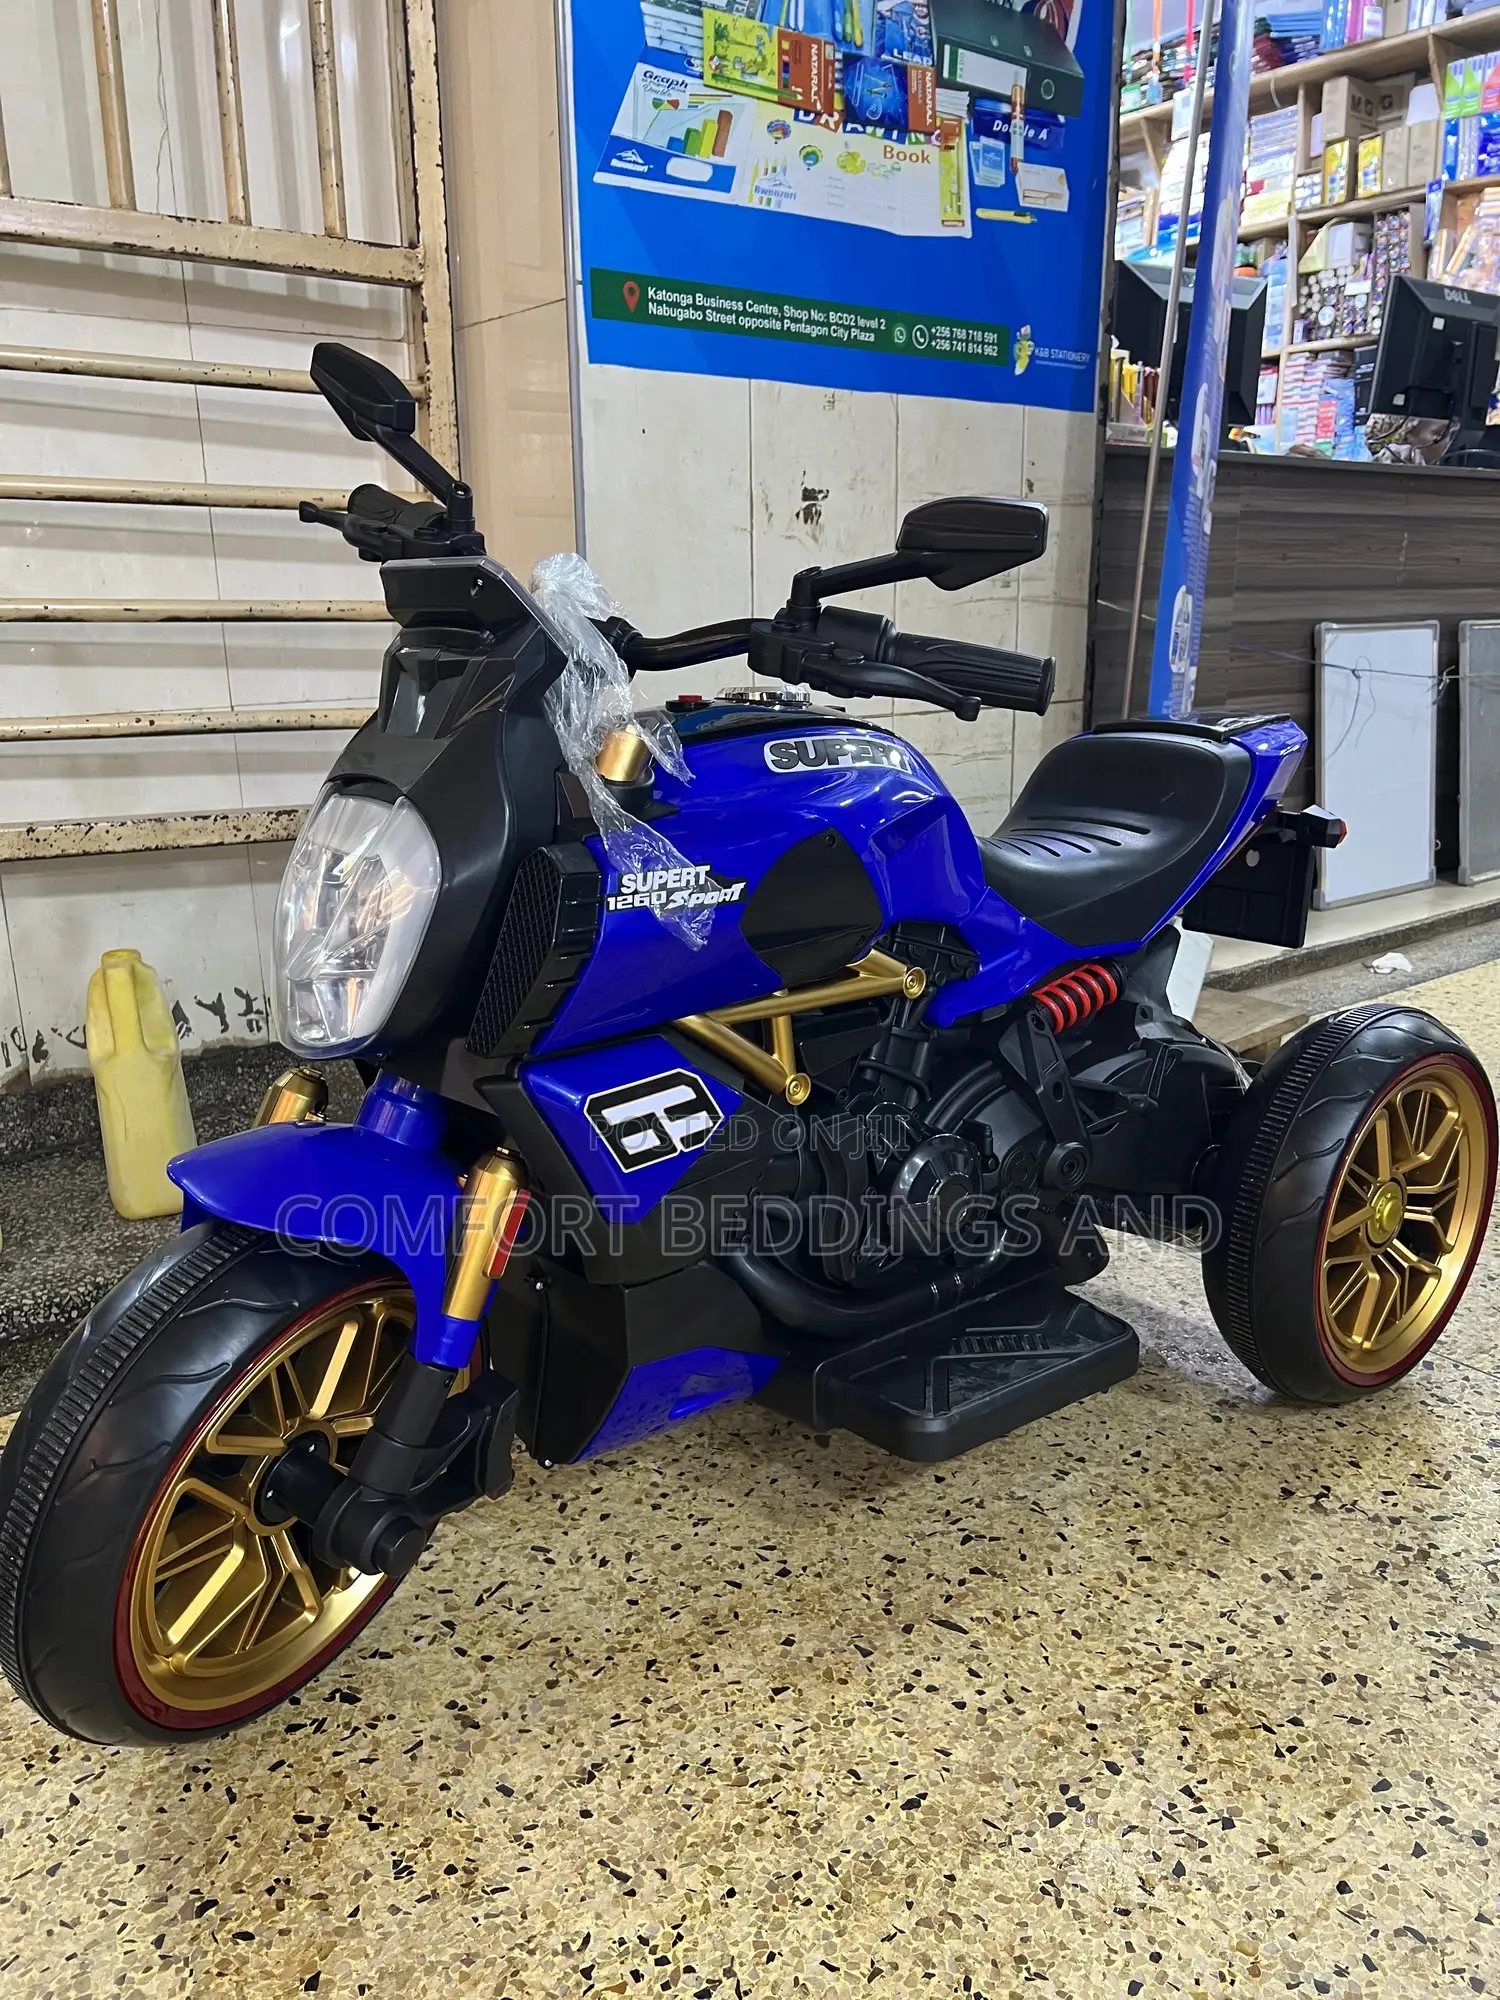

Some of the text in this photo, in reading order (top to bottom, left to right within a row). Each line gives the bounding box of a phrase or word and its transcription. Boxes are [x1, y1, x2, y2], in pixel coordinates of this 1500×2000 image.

[643, 70, 688, 89] Graph
[993, 120, 1049, 140] Dole A
[882, 145, 931, 164] Book
[1443, 287, 1472, 305] DELL
[647, 286, 886, 330] Katonga Business Centre, Shop No: BCD2 level 2
[648, 301, 875, 341] Nabugabo Street opposite Pentagon City Plaza
[931, 325, 951, 338] +256
[952, 328, 967, 340] 768
[968, 329, 983, 342] 718
[931, 338, 951, 351] +256
[952, 340, 967, 352] 741
[967, 342, 982, 354] 814
[620, 865, 710, 894] SUPERT
[607, 891, 667, 911] 1260
